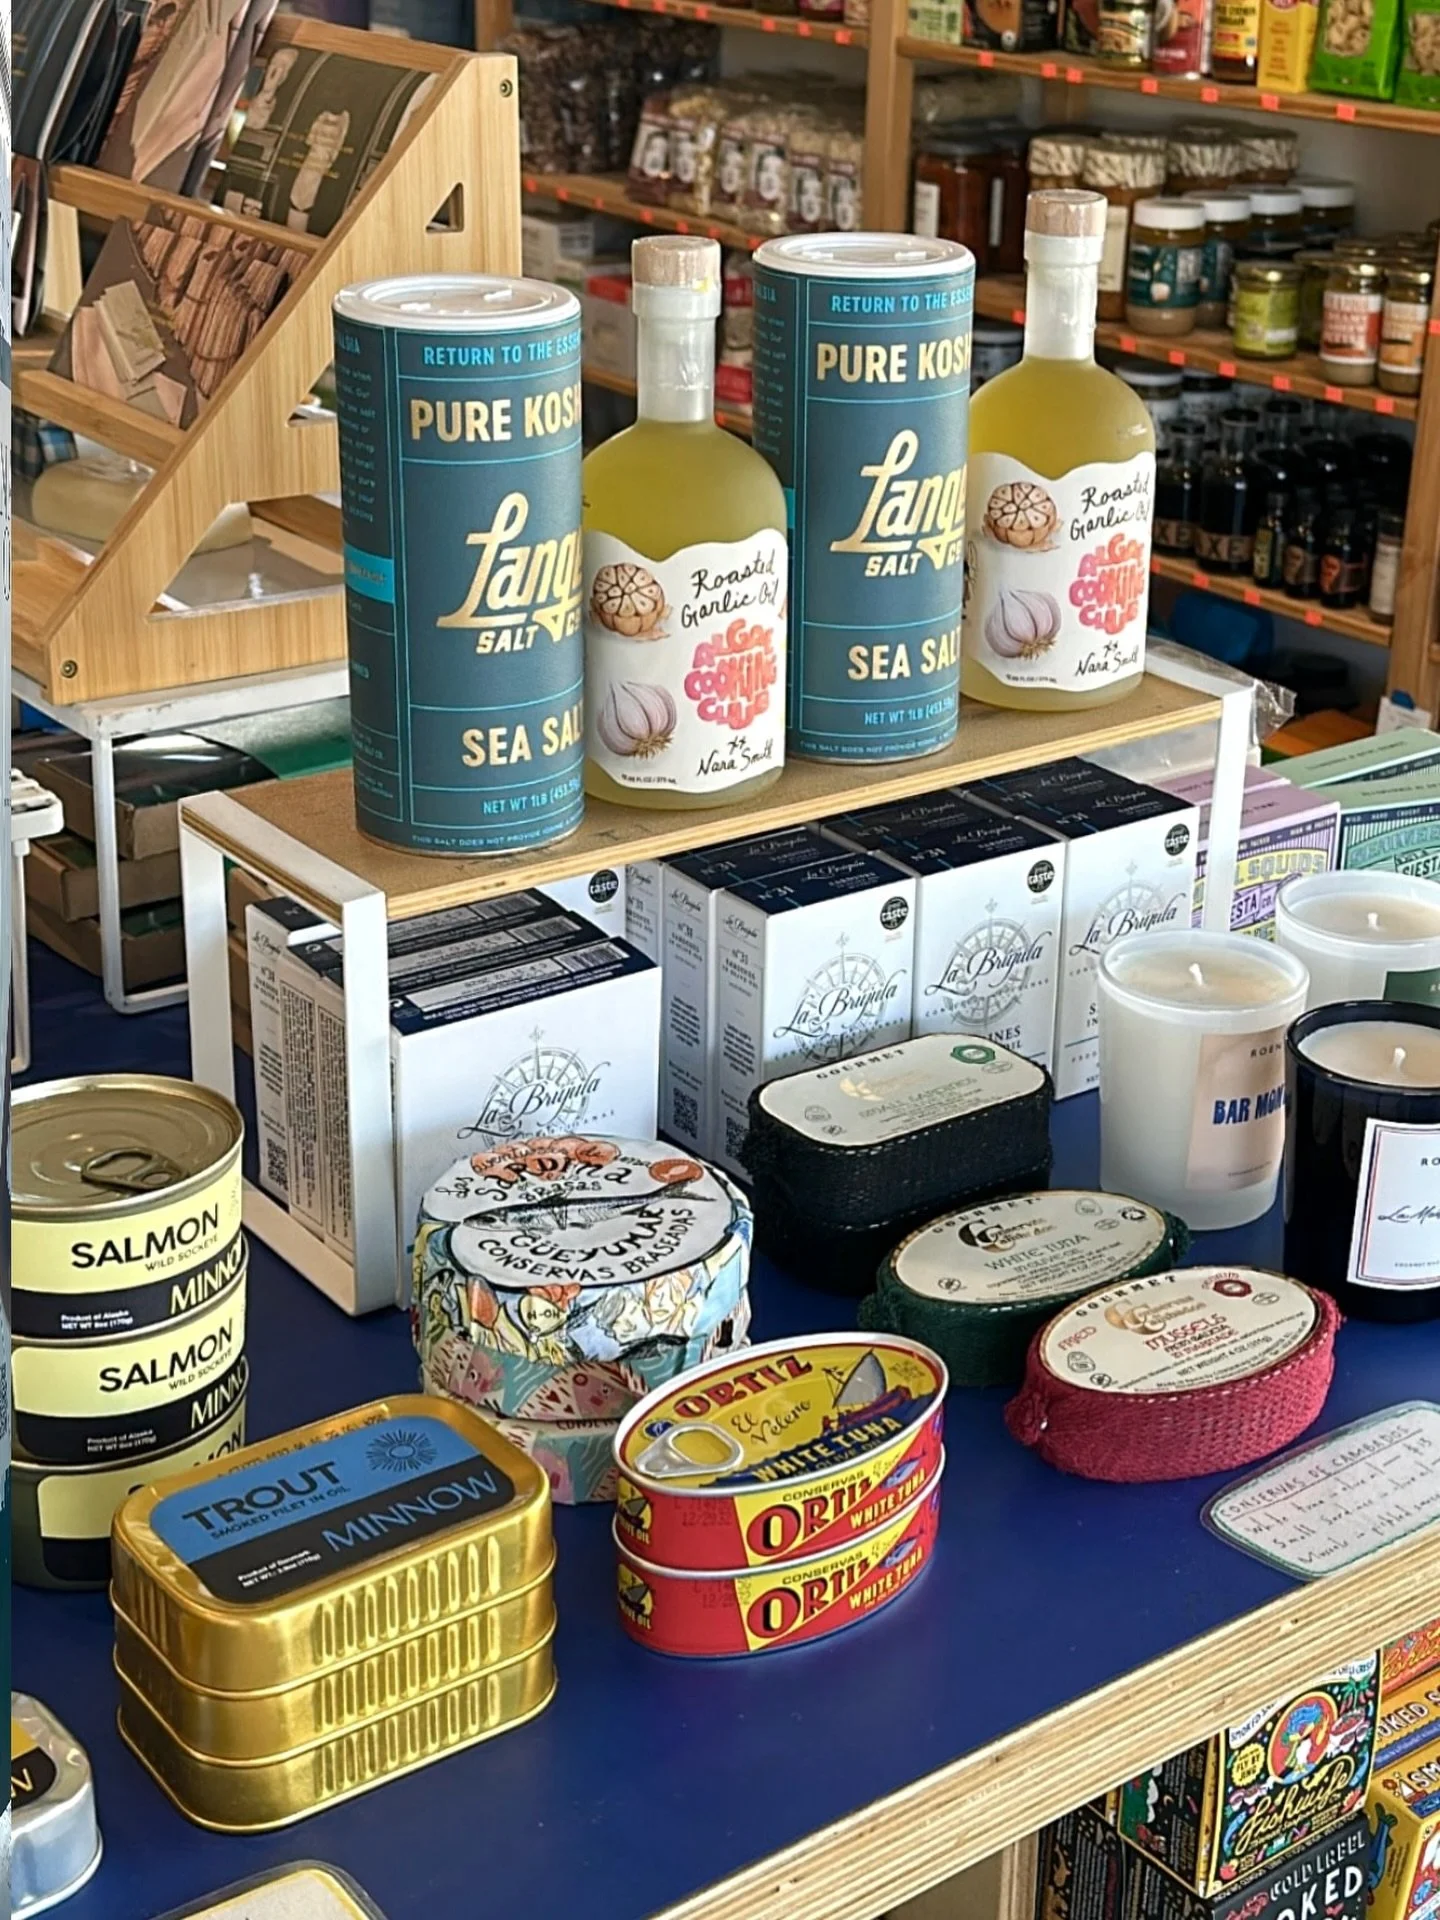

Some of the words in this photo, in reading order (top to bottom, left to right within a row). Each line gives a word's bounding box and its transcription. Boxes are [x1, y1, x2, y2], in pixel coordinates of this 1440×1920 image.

[831, 295, 895, 314] RETURN
[901, 295, 920, 312] TO
[925, 292, 948, 310] THE
[423, 346, 495, 366] RETURN
[501, 345, 522, 364] TO
[528, 340, 553, 361] THE
[816, 343, 907, 383] PURE
[411, 399, 512, 442] PURE
[1070, 506, 1135, 541] Garlic
[691, 548, 776, 599] Roasted
[865, 553, 923, 577] SALT
[681, 592, 758, 628] Garlic
[475, 625, 540, 655] SALT
[848, 643, 912, 681] SEA
[864, 711, 885, 726] NET
[888, 709, 906, 724] WT
[461, 724, 532, 768] SEA
[483, 799, 505, 816] NET
[509, 796, 528, 812] WT
[1165, 831, 1191, 848] taste
[588, 878, 619, 894] taste
[1027, 870, 1056, 886] taste
[881, 904, 909, 922] taste
[816, 1049, 905, 1079] GOURMET
[1212, 1097, 1250, 1126] BAR
[932, 1196, 1042, 1234] GOURMET
[71, 1202, 219, 1269] SALMON
[145, 1256, 175, 1273] WILD
[178, 1233, 219, 1262] SOCKEYE
[477, 1238, 615, 1282] CONSERVAS
[620, 1207, 697, 1276] BRASEADAS
[984, 1248, 1044, 1271] WHITE
[1075, 1275, 1178, 1318] GOURMET
[99, 1317, 234, 1394] SALMON
[168, 1373, 195, 1391] WILD
[198, 1348, 234, 1379] SOCKEYE
[672, 1353, 813, 1418] ORTIZ
[752, 1442, 835, 1482] WHITE
[831, 1416, 903, 1449] TUNA
[181, 1461, 344, 1531] TROUT
[782, 1470, 865, 1503] CONSERVAS
[849, 1492, 896, 1530] WHITE
[897, 1467, 926, 1500] TUNA
[1220, 1476, 1307, 1518] CONSERVAS
[210, 1513, 269, 1540] SMOKED
[271, 1498, 308, 1517] FILET
[309, 1493, 326, 1504] IN
[321, 1470, 498, 1552] MINNOW
[746, 1476, 873, 1557] ORTIZ
[782, 1551, 864, 1586] CONSERVAS
[849, 1572, 894, 1611] WHITE
[895, 1545, 924, 1578] TUNA
[746, 1557, 871, 1639] ORTIZ
